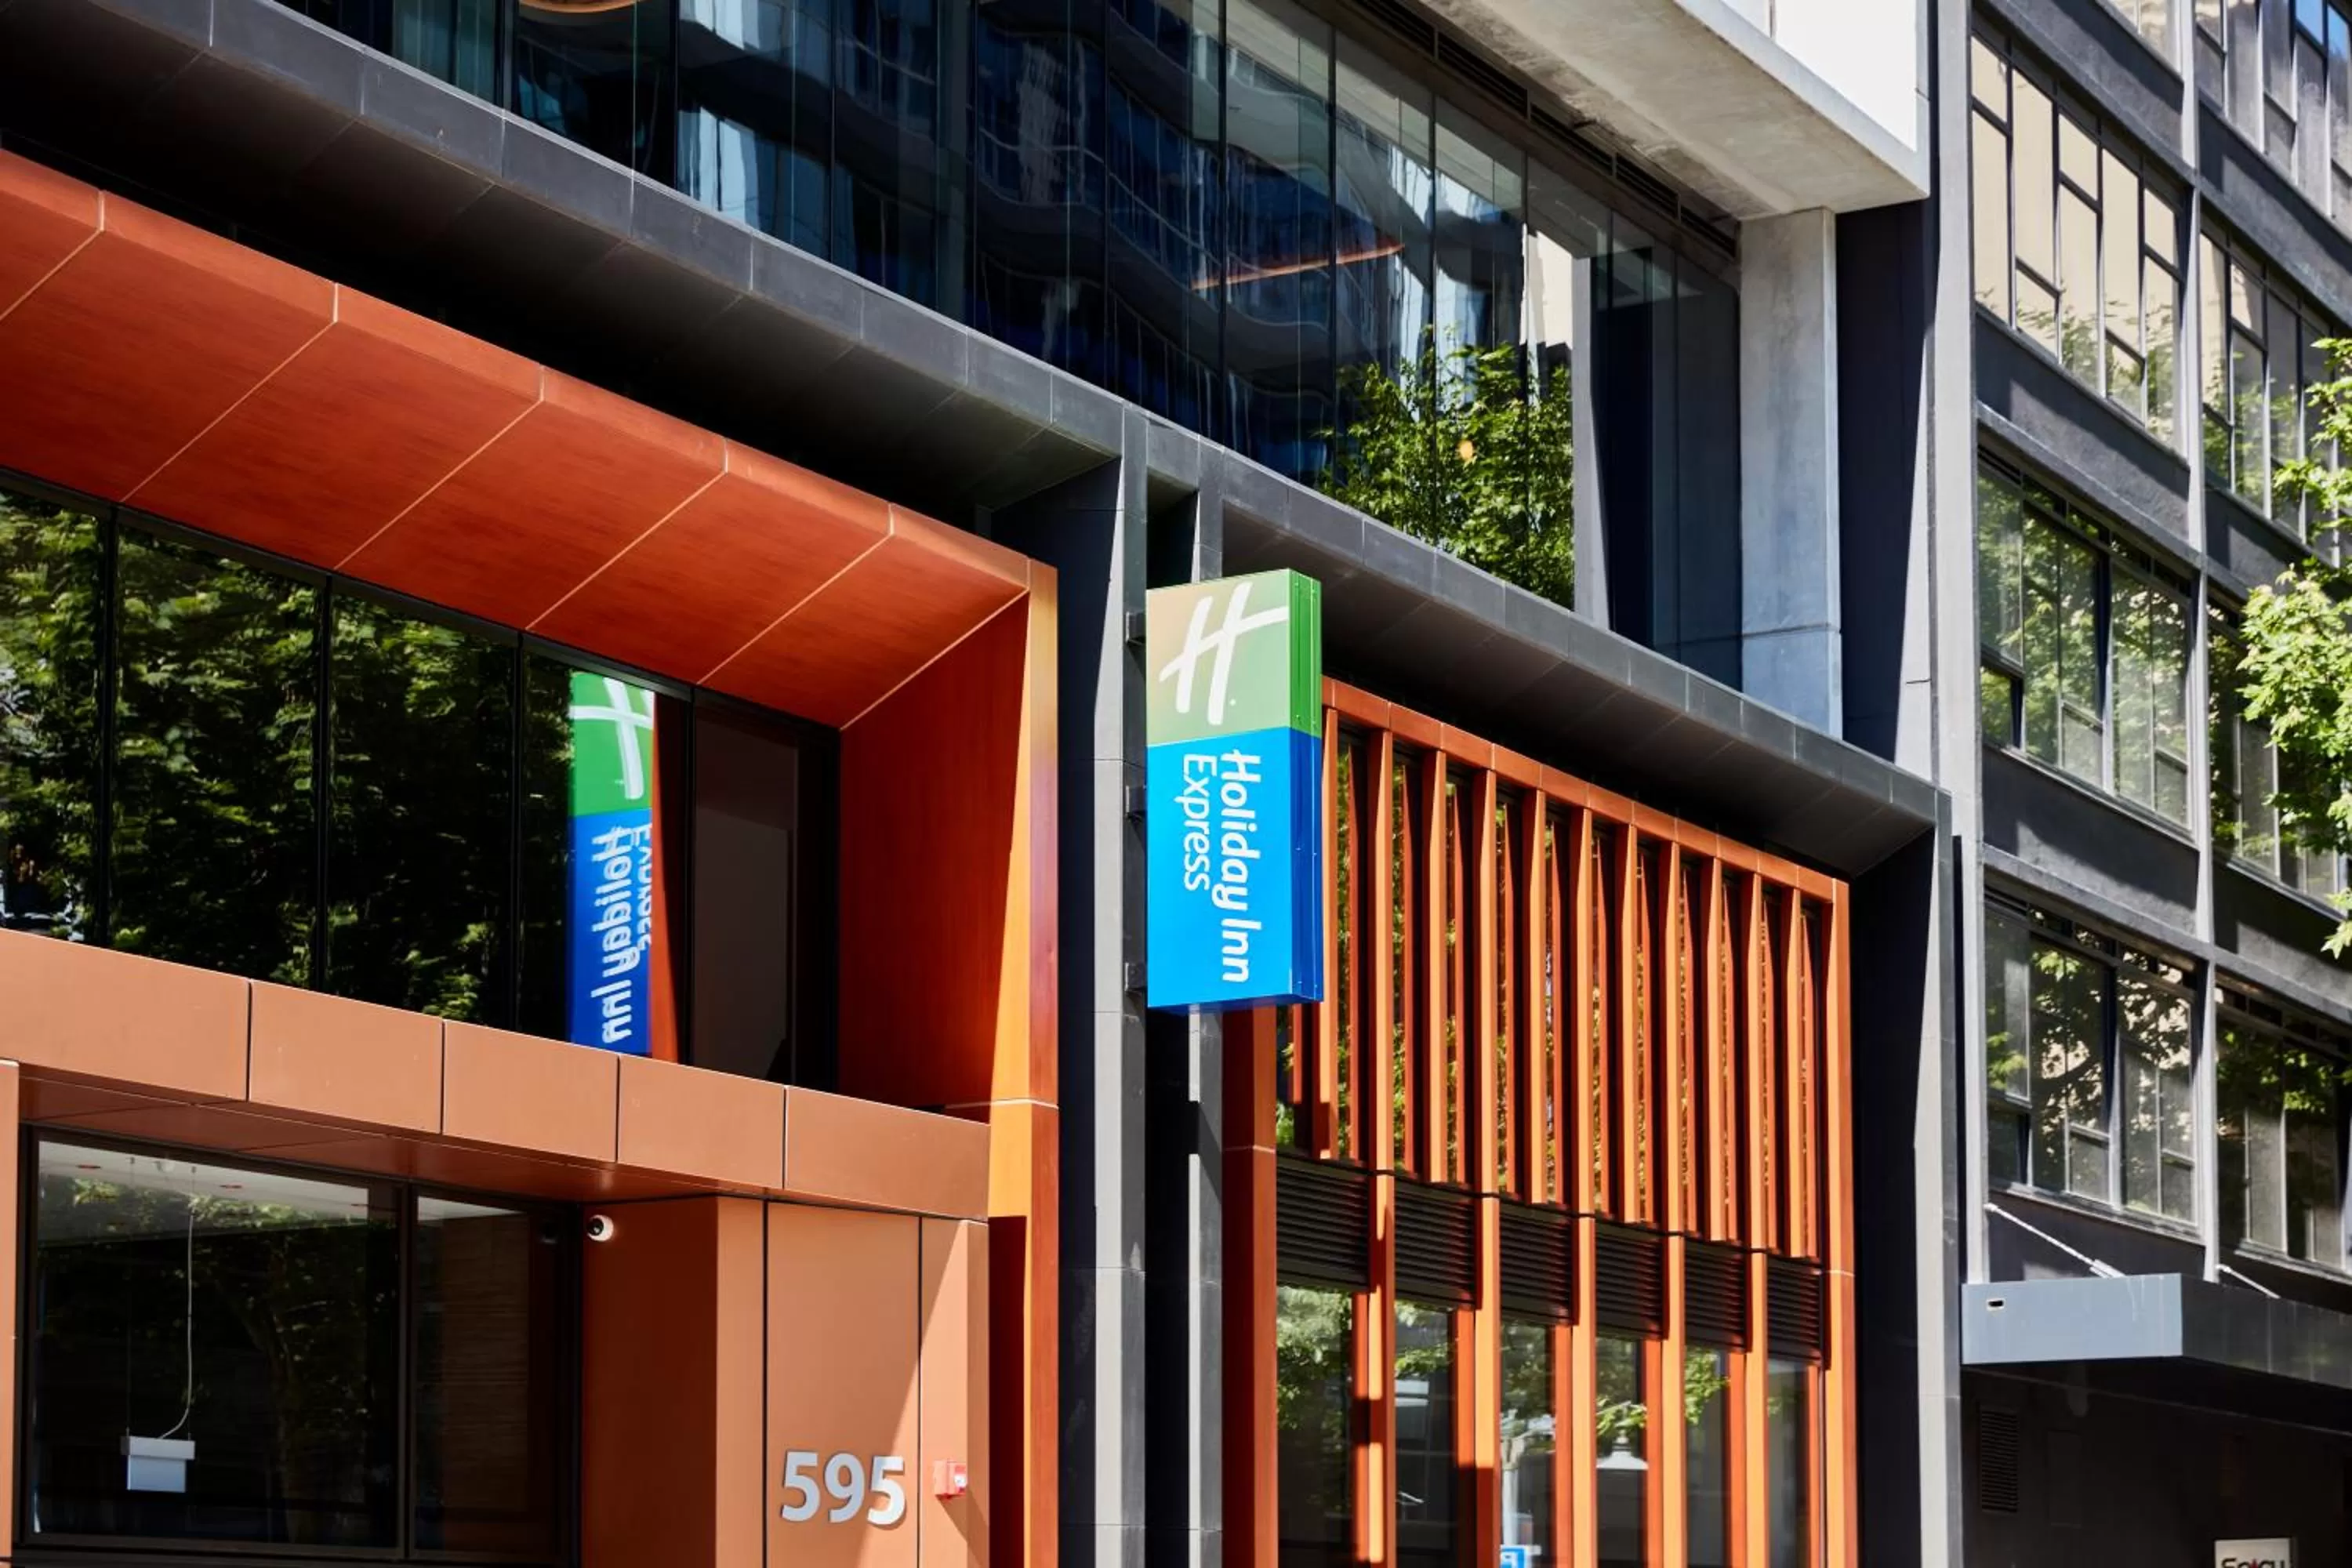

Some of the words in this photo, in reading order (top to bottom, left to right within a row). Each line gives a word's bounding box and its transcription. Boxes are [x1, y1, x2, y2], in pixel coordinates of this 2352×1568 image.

[1174, 753, 1218, 891] Express
[1211, 749, 1261, 912] Holiday
[1221, 918, 1262, 983] Inn
[782, 1451, 906, 1526] 595
